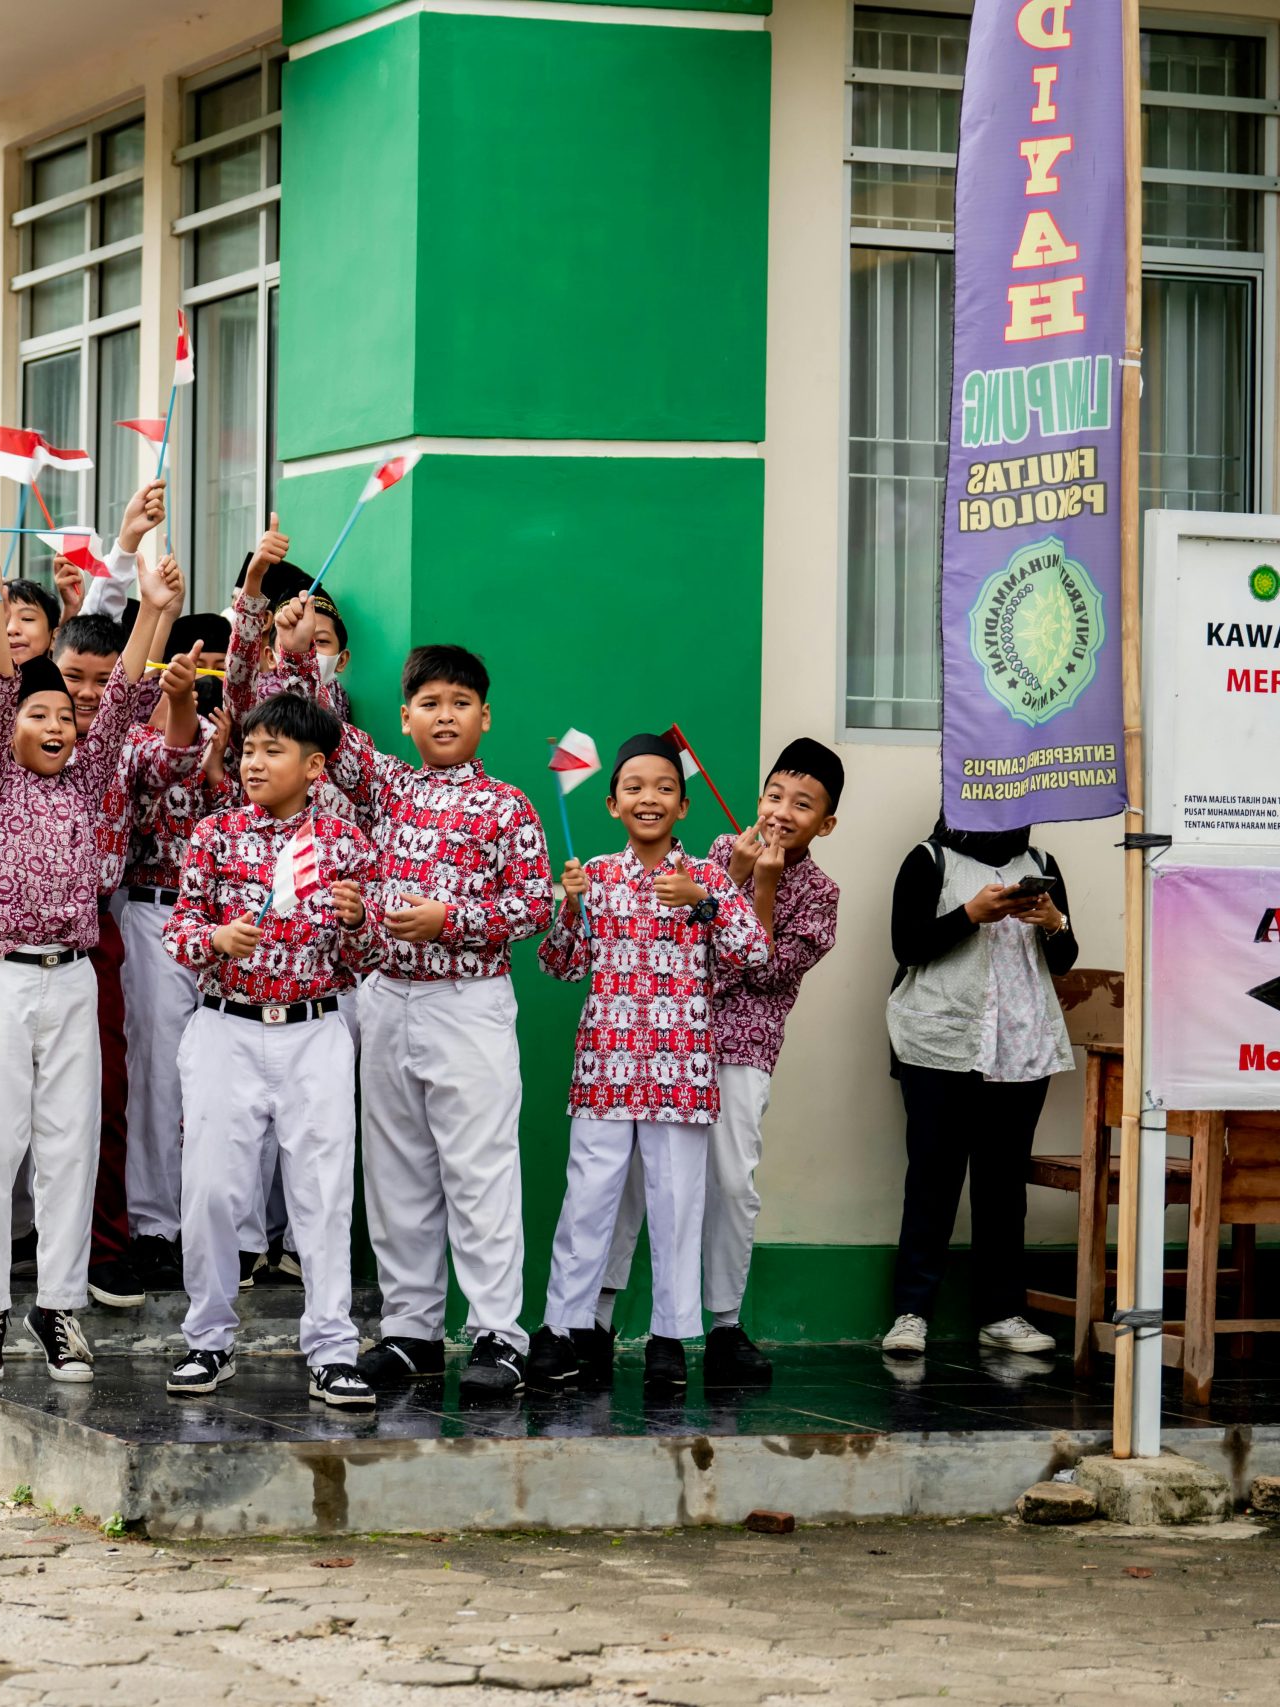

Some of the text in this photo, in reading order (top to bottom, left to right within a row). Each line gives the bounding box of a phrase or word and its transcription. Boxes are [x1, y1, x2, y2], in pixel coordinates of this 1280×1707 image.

[1184, 795, 1207, 803] FATWA
[1209, 795, 1236, 804] MAJELIS
[1238, 796, 1261, 804] TARJIH
[1262, 796, 1276, 804] DAN
[1184, 808, 1279, 817] PUSAT MUHAMMADIYAH NO.
[1184, 820, 1215, 829] TENTANG
[1217, 821, 1239, 829] FATWA
[1241, 821, 1266, 830] HARAM
